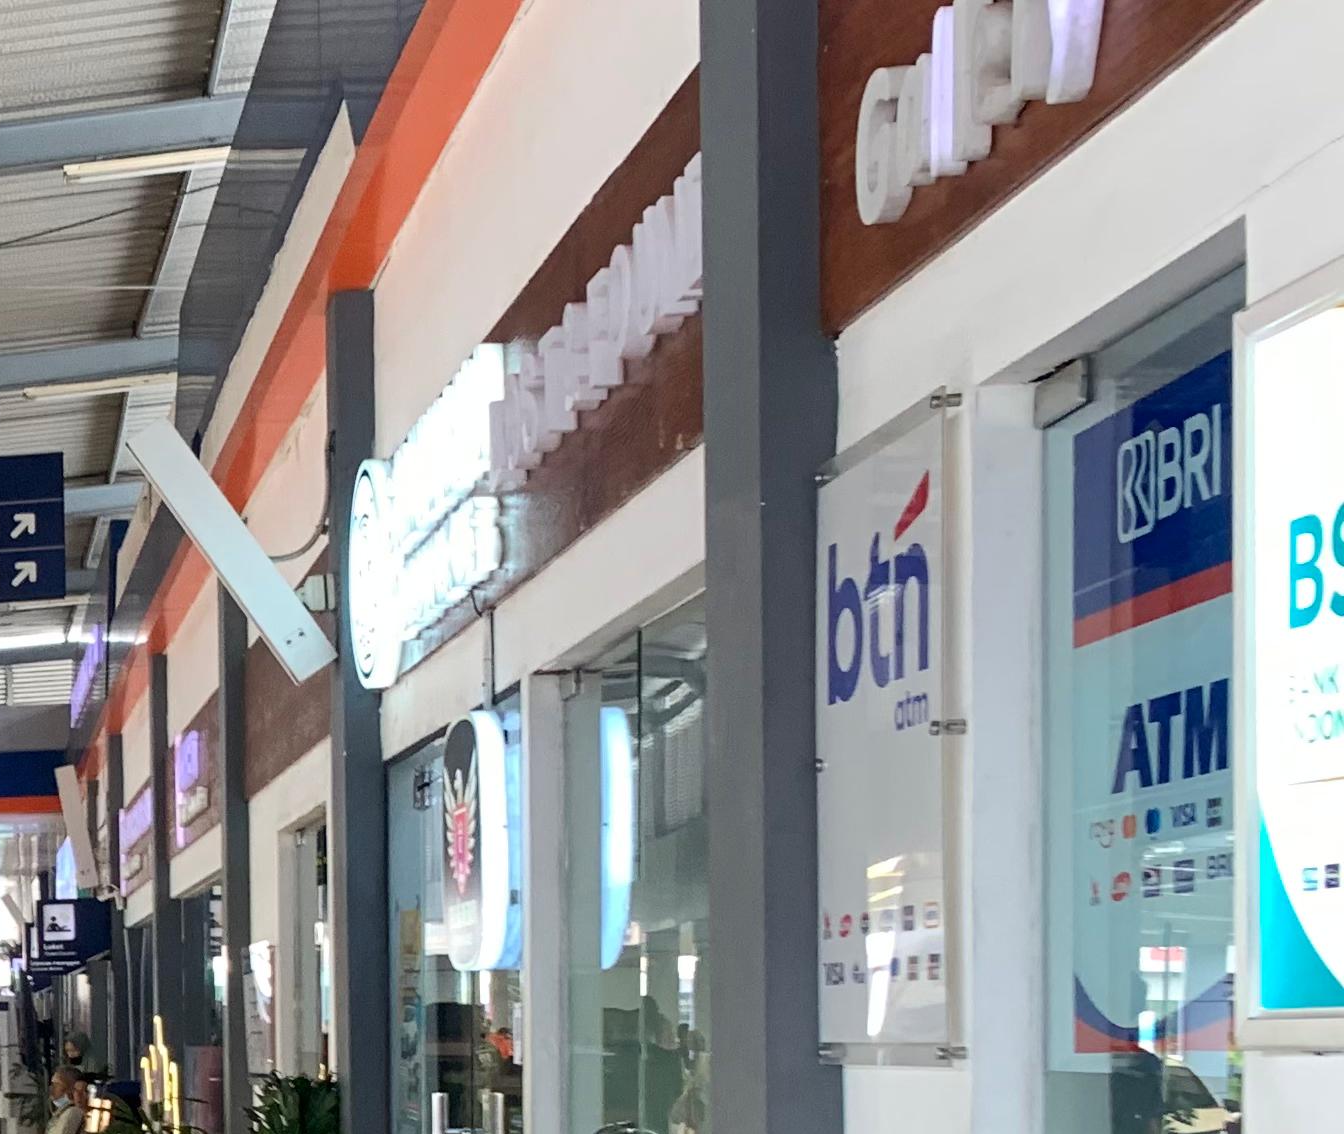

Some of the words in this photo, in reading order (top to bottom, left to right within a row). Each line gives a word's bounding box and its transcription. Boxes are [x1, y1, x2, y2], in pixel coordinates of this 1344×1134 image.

[1157, 404, 1221, 521] BRI
[828, 531, 929, 706] btn
[895, 691, 929, 731] atm
[1111, 677, 1230, 795] ATM
